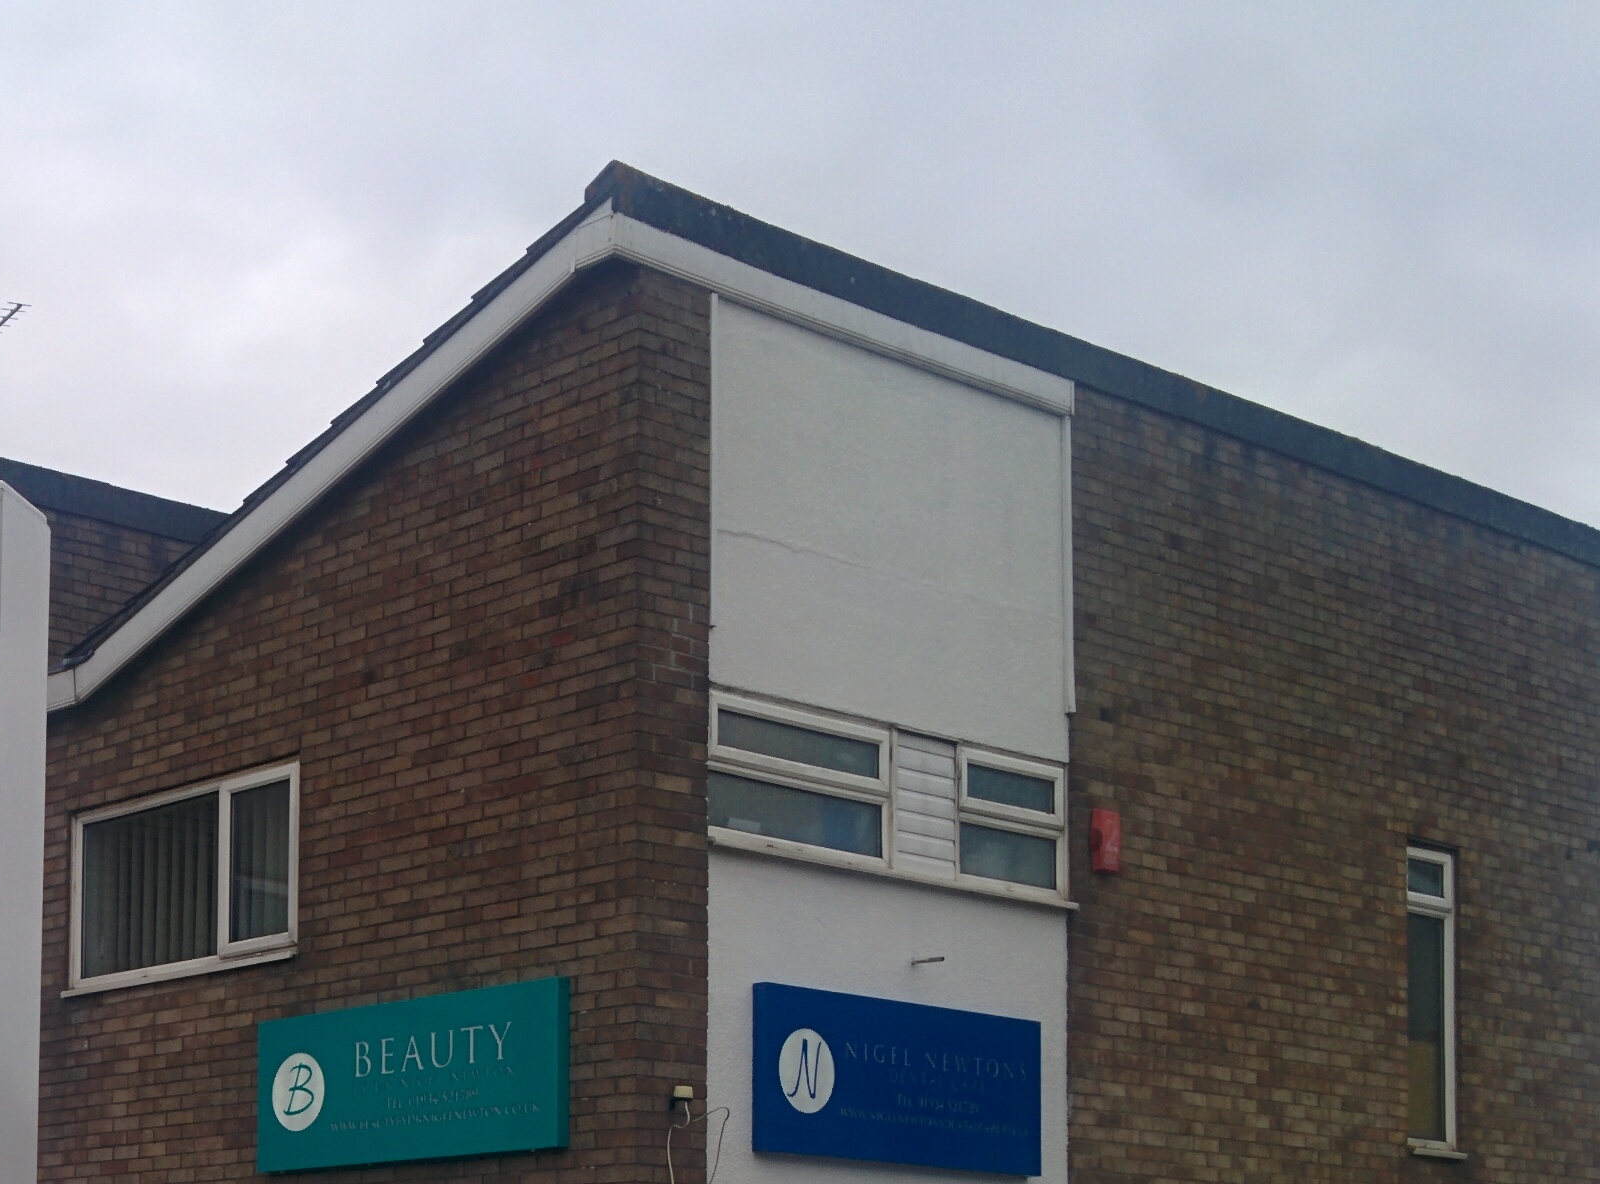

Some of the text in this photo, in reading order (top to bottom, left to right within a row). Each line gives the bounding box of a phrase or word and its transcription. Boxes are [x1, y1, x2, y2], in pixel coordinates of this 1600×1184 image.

[354, 1021, 512, 1078] BEAUTY
[787, 1038, 822, 1099] N
[845, 1041, 1026, 1081] NIGEL NEWTONS
[283, 1063, 315, 1116] B
[400, 1073, 441, 1089] NIGEL
[452, 1066, 514, 1083] NEWTON
[889, 1068, 986, 1094] DENTAL CARE
[408, 1094, 439, 1107] 01934
